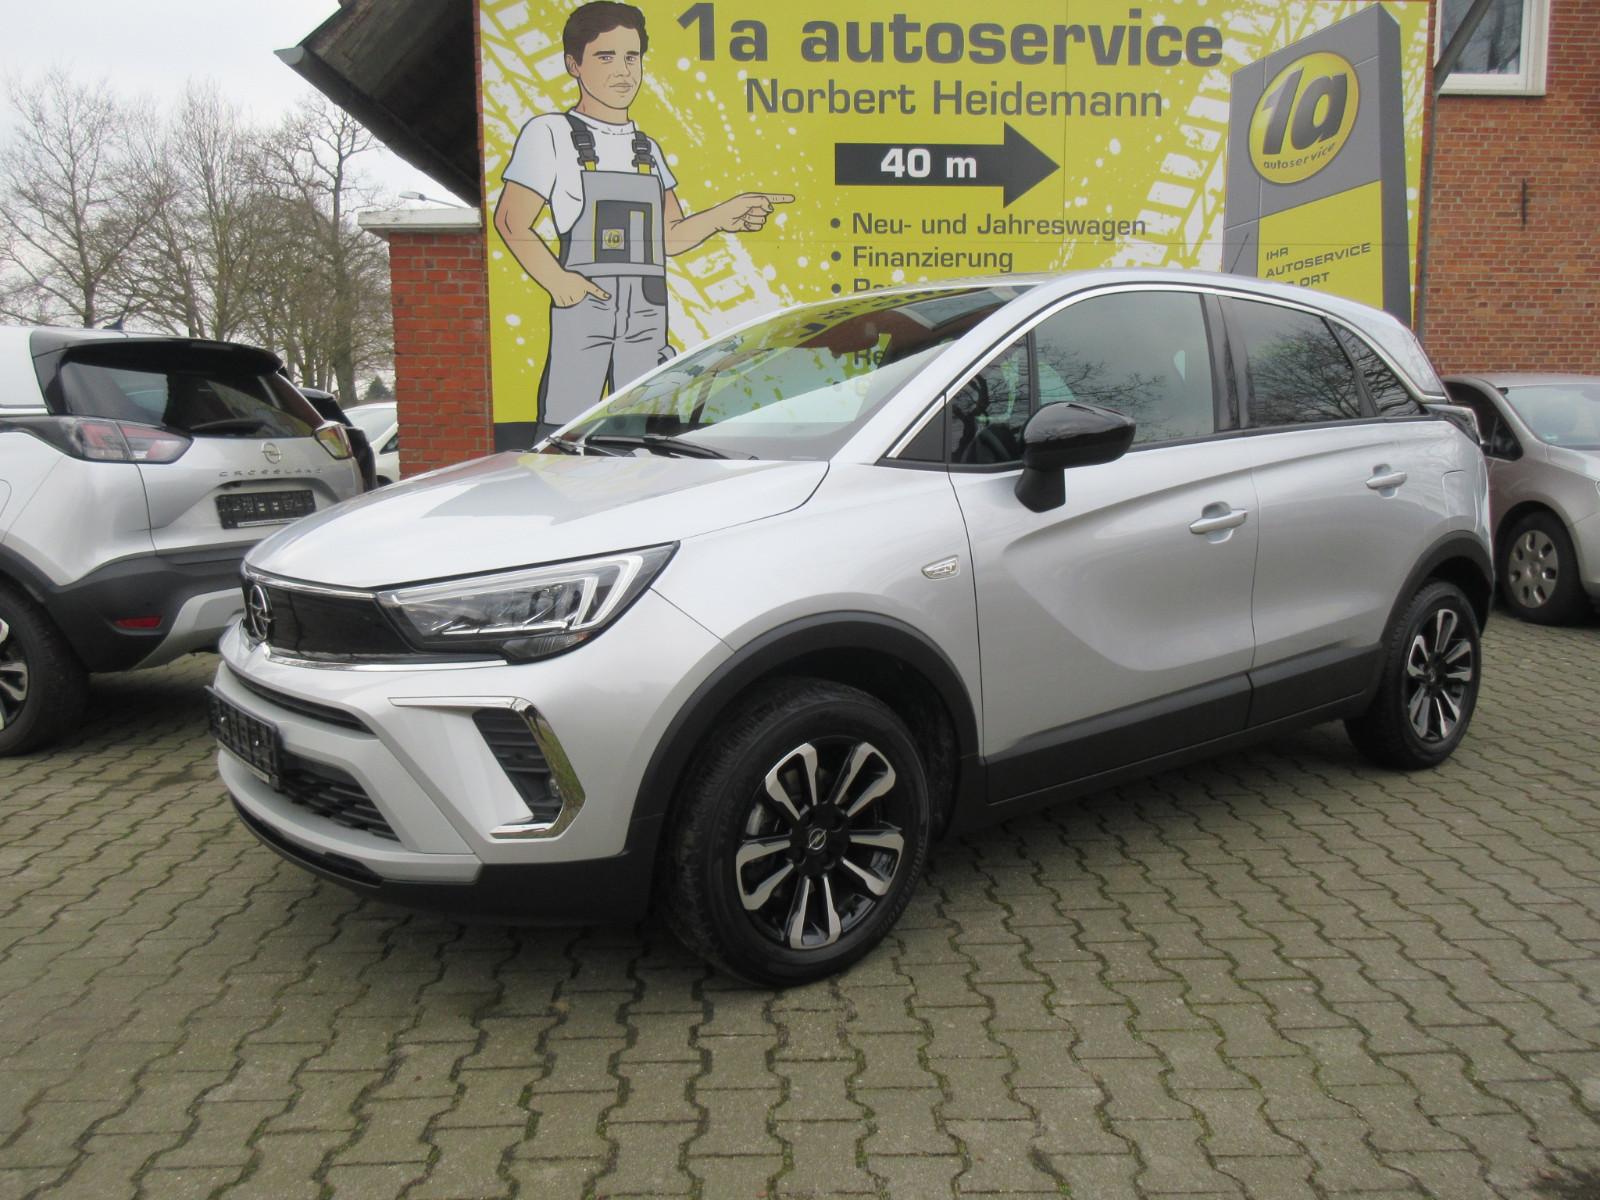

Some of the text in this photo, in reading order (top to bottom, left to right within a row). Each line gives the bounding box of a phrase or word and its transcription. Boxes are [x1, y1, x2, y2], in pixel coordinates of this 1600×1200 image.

[677, 2, 1223, 67] 1a autoservice
[746, 78, 1162, 117] Norbert Heidemann
[1262, 66, 1348, 155] 1a
[880, 148, 977, 178] 40 m
[1263, 142, 1336, 169] autoservice
[852, 212, 1146, 242] Neu- und Jahreswagen
[853, 246, 1013, 274] Finanzierung
[1266, 247, 1289, 261] IHR
[1266, 243, 1371, 278] AUTOSERVICE
[1300, 272, 1330, 287] ORT
